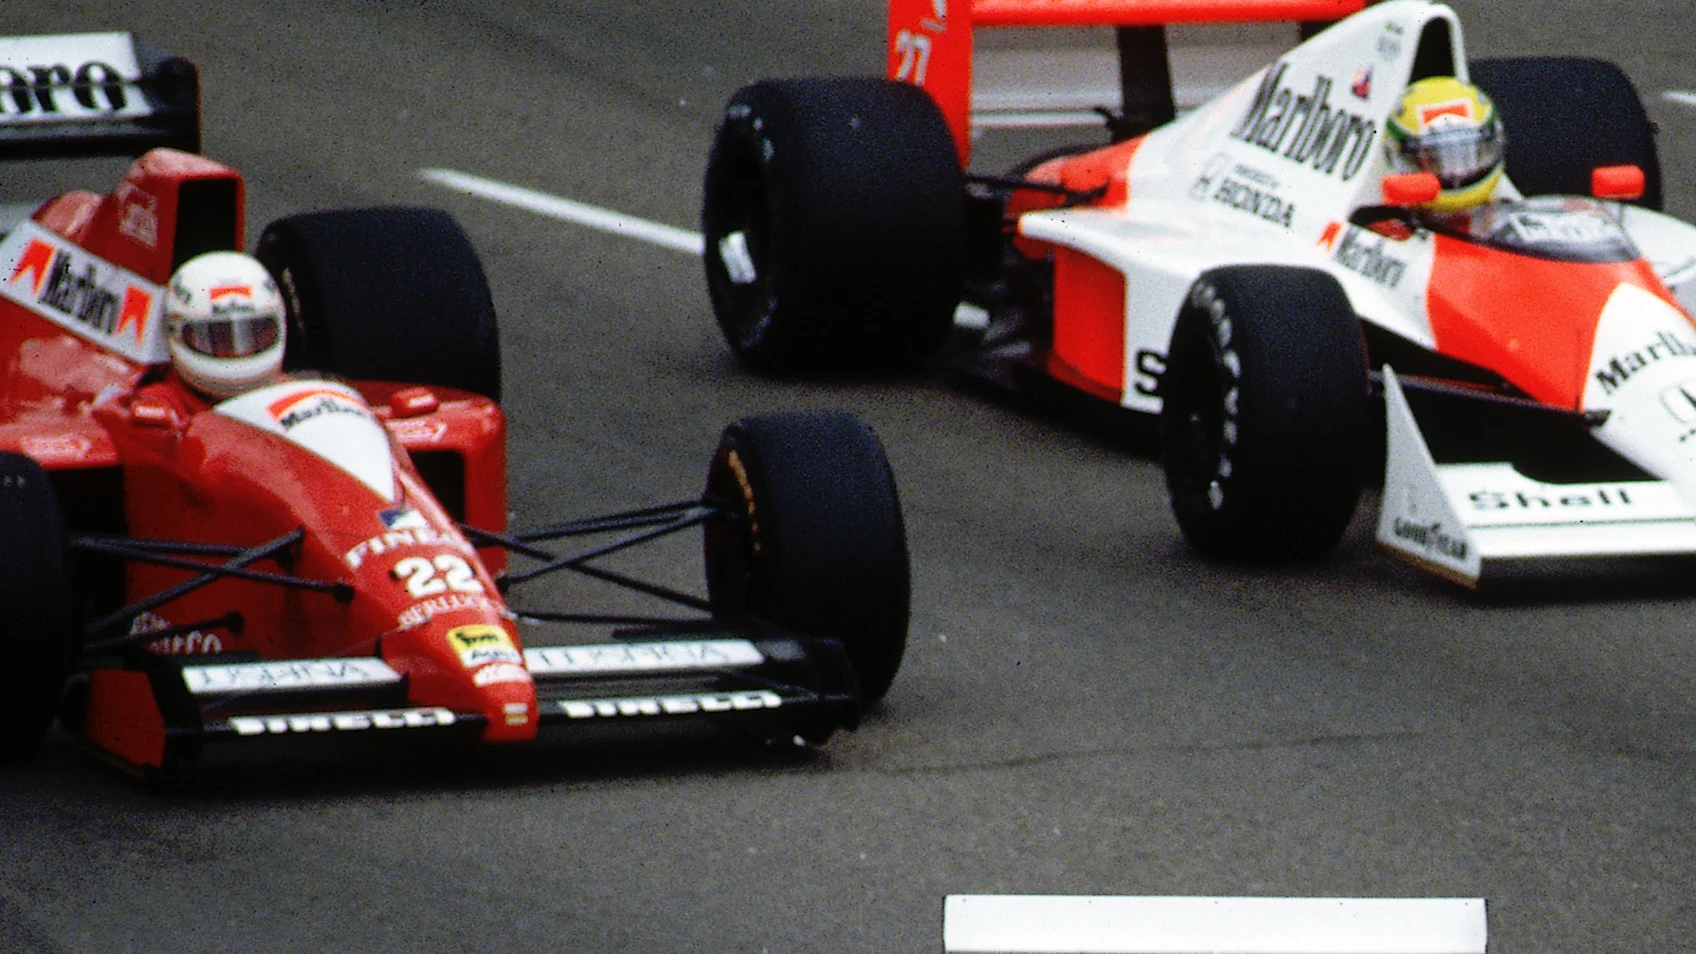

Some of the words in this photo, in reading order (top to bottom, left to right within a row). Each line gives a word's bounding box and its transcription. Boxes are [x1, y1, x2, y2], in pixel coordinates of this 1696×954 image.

[1229, 62, 1375, 181] Marlboro
[1214, 177, 1294, 228] HONDA
[1469, 490, 1631, 508] Shell
[394, 555, 484, 598] 22
